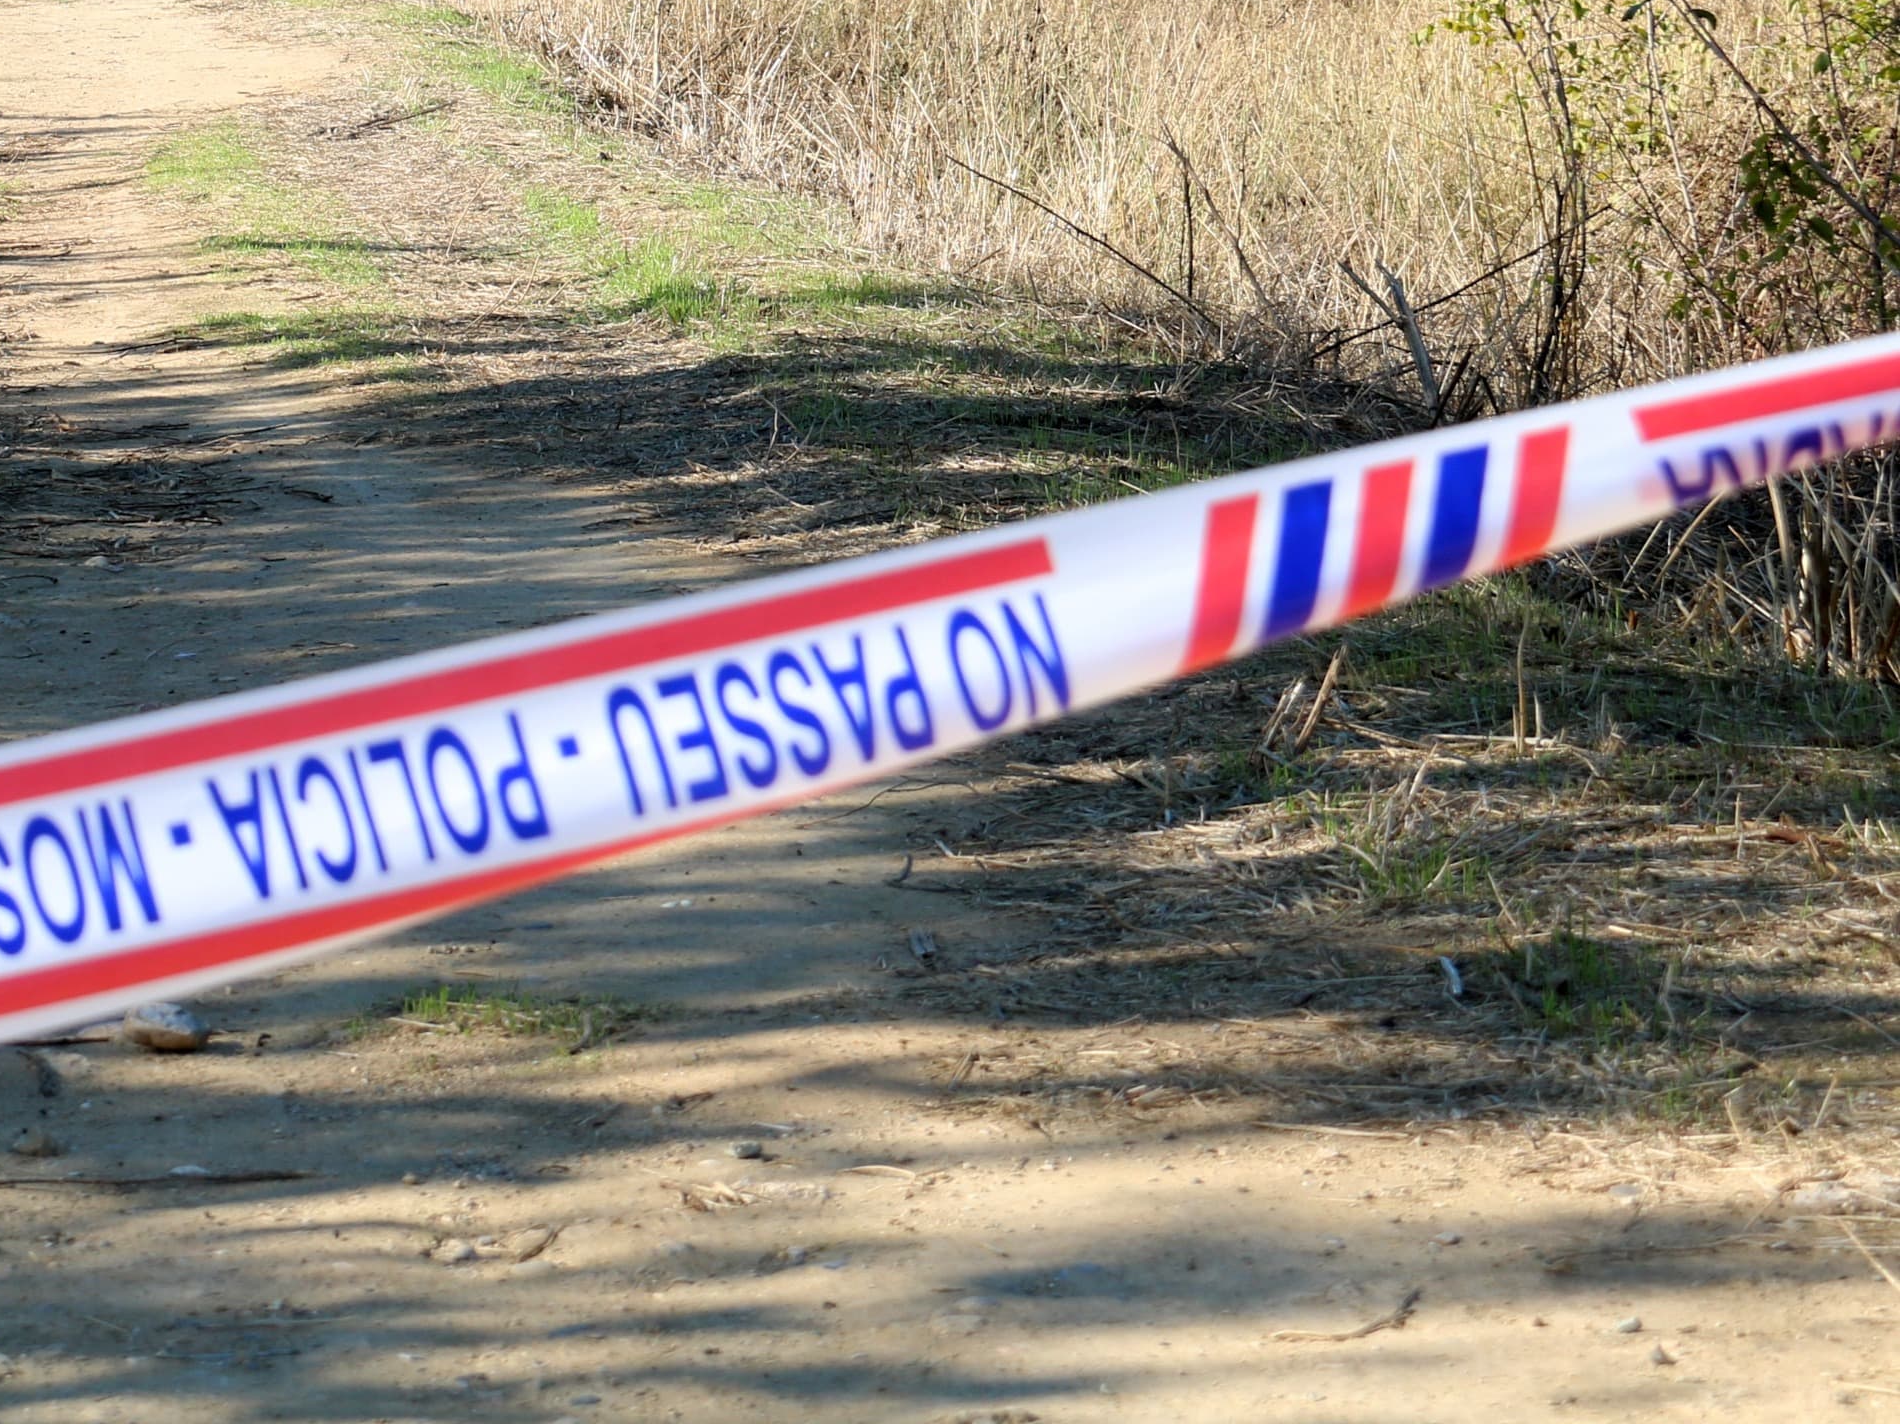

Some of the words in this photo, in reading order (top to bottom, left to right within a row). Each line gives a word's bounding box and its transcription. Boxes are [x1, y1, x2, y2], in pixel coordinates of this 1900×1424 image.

[602, 622, 935, 820] PASSEU
[944, 590, 1071, 732] NO
[201, 708, 556, 905] POLICIA
